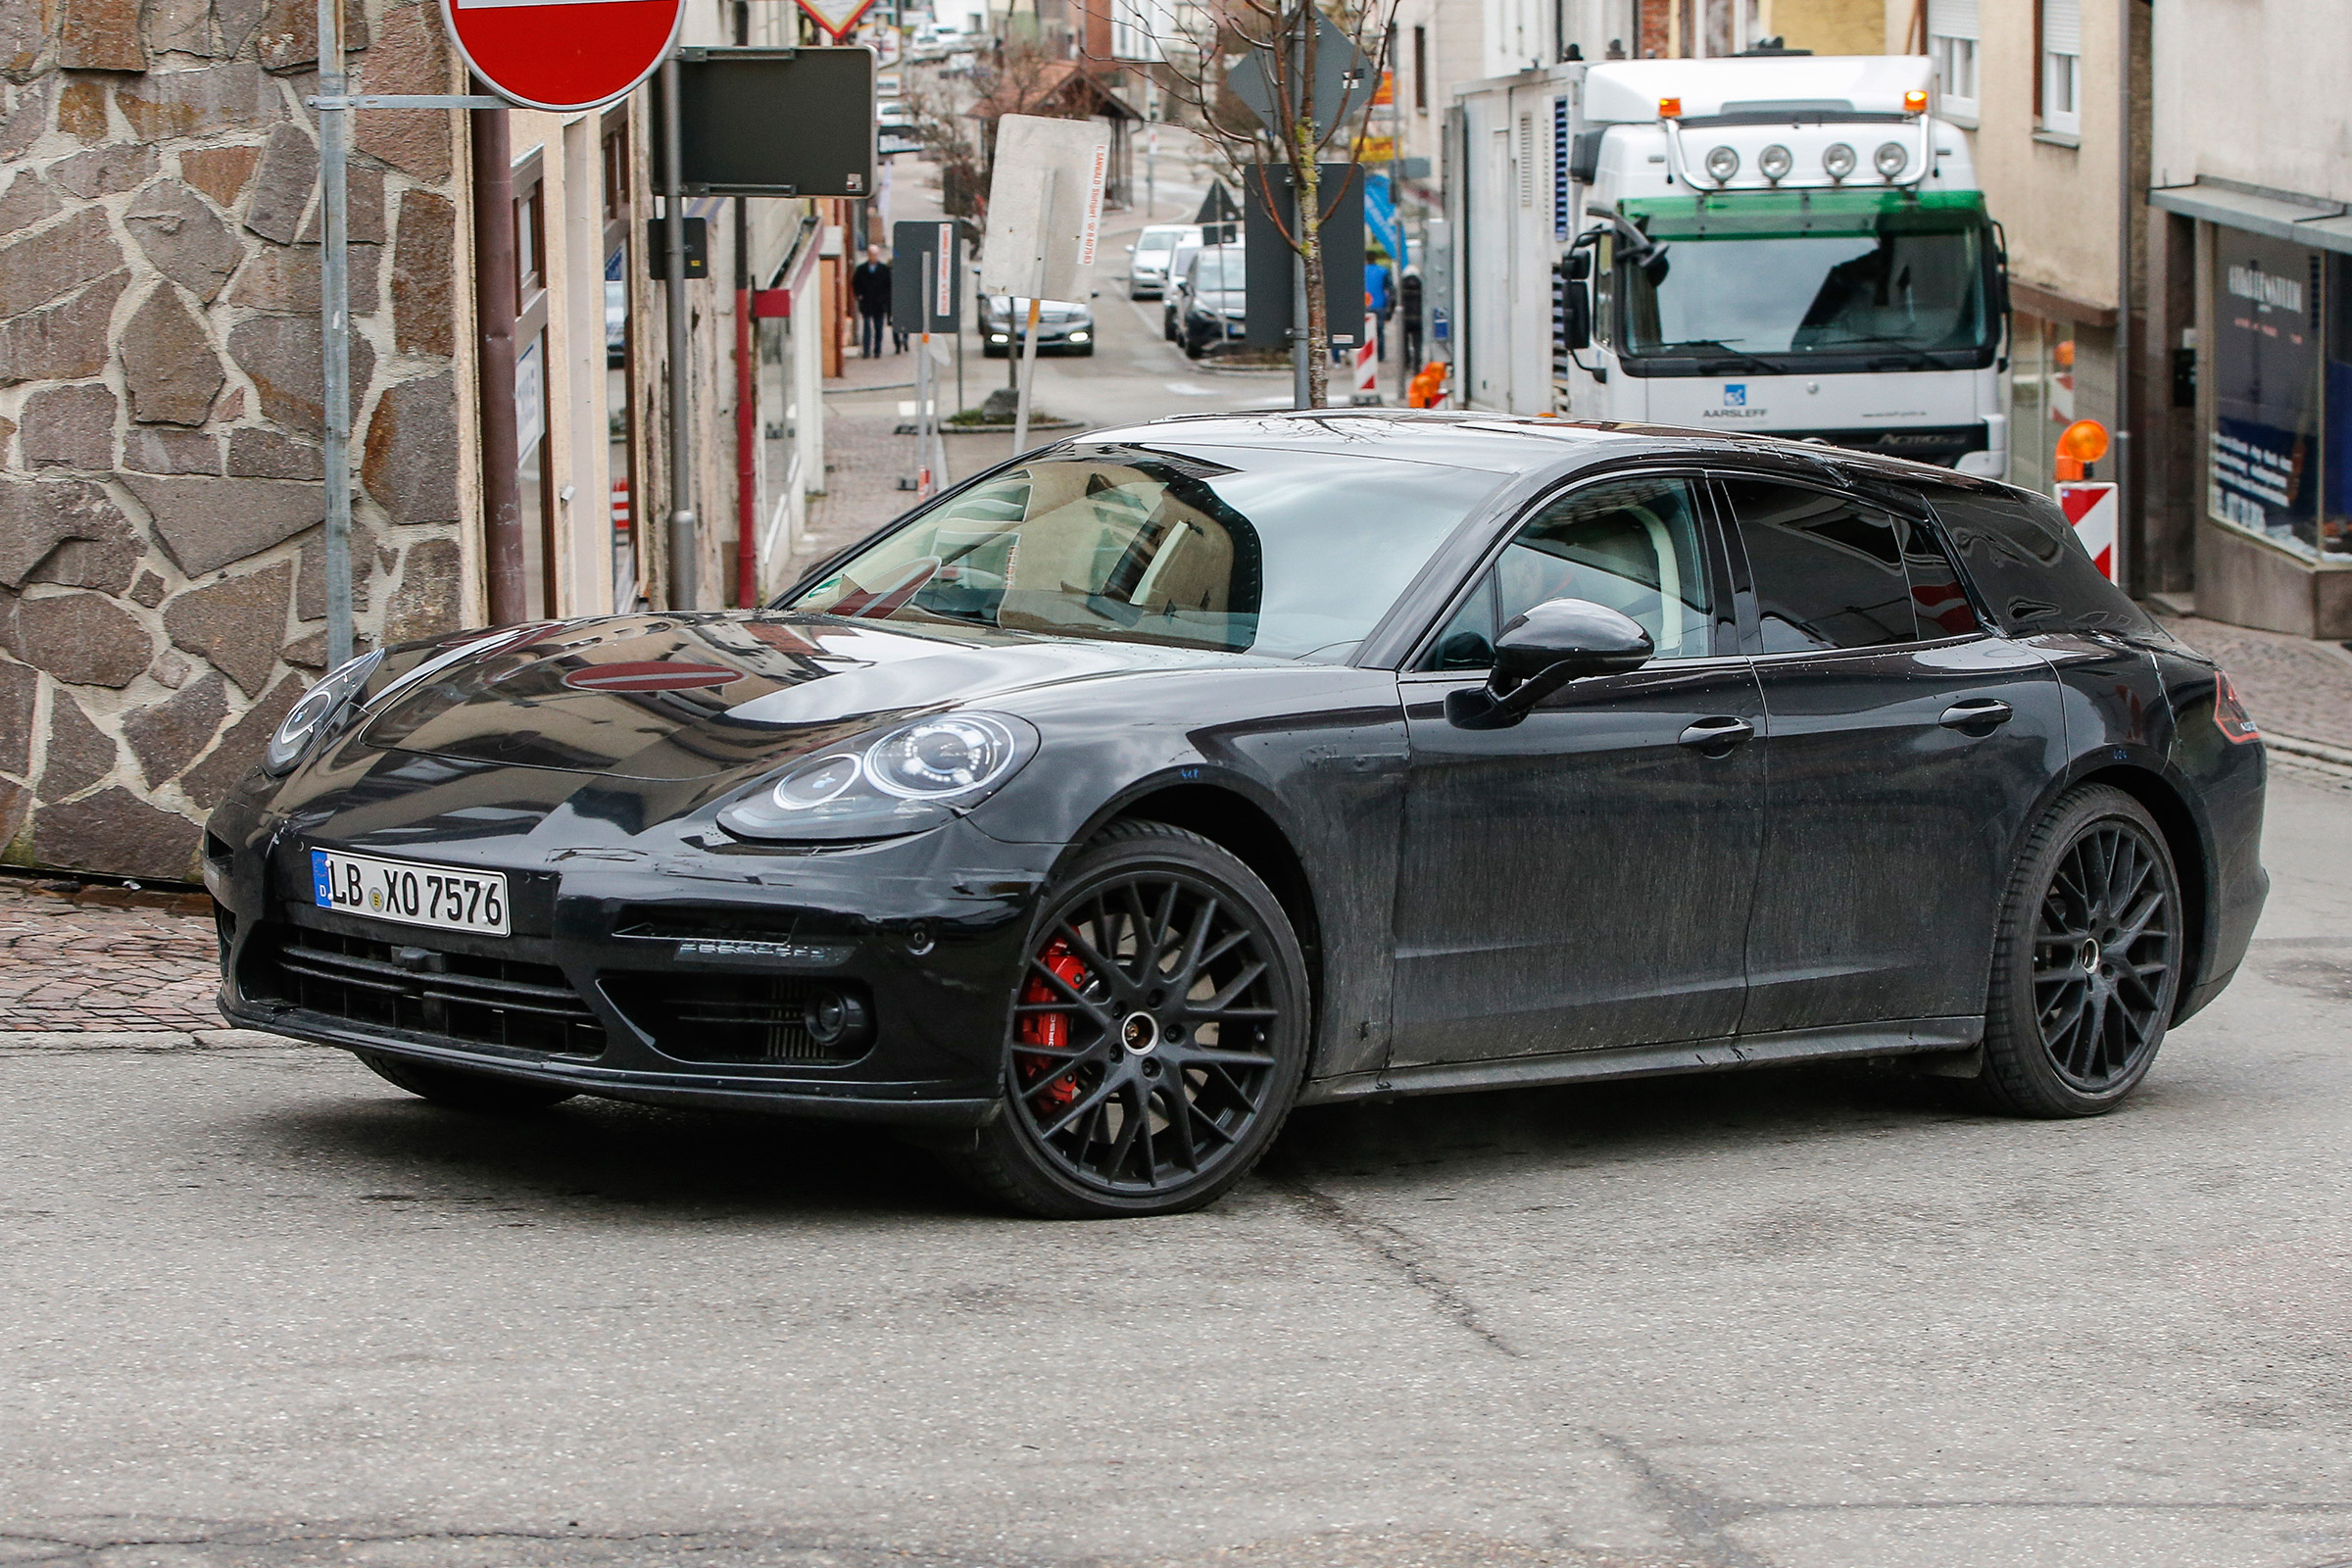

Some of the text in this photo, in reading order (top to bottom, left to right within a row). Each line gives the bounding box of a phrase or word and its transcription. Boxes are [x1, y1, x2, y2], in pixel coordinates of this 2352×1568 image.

[1702, 408, 1768, 418] AARSLEFF
[319, 884, 327, 898] D
[330, 859, 364, 906] LB
[426, 875, 502, 926] 7576
